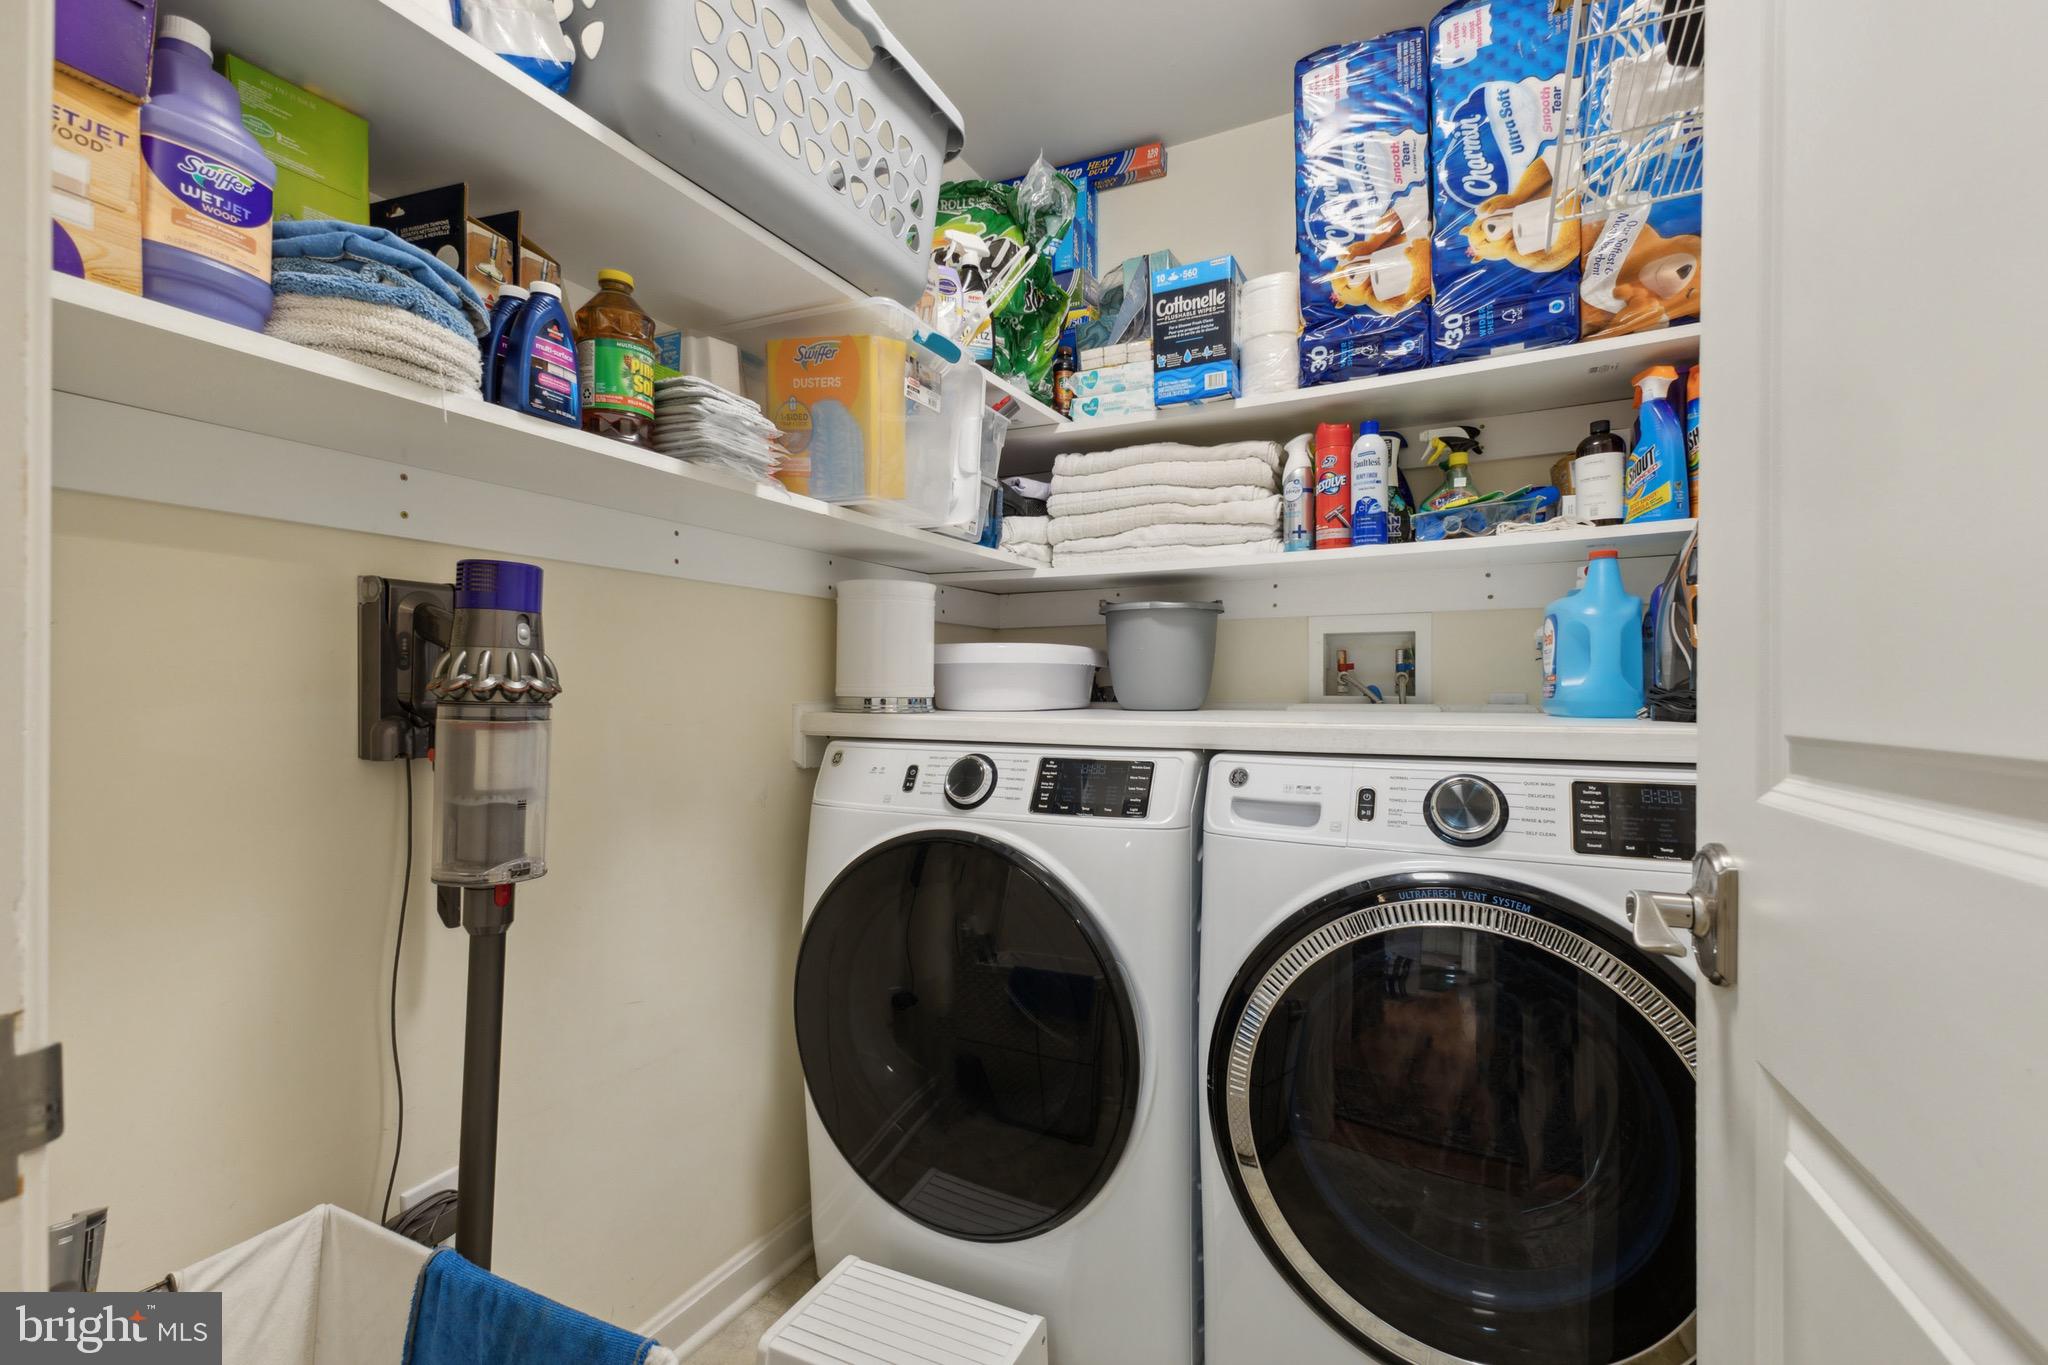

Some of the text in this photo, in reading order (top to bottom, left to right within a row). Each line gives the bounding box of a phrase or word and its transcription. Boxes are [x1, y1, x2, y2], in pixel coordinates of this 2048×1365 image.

[1540, 86, 1552, 133] Smooth
[1552, 86, 1562, 113] Tear
[1496, 88, 1525, 155] Ultra Soft
[53, 124, 105, 153] OOD
[1087, 157, 1118, 170] HEAVY
[1402, 141, 1410, 167] Tear
[1453, 113, 1498, 197] Charmin
[177, 155, 253, 196] Swiffer
[1088, 166, 1110, 177] DUTY
[201, 203, 238, 224] WOOD
[940, 197, 976, 210] ROLLS
[1156, 273, 1166, 283] 10
[1156, 288, 1226, 317] Cottonelle
[1165, 306, 1217, 321] FLUSHABLE WIPES
[1444, 313, 1463, 347] 30
[793, 344, 840, 368] Swiffer
[793, 376, 842, 389] DUSTERS
[1353, 457, 1381, 469] Faultless
[1398, 889, 1532, 914] ULTRAFRESH VENT SYSTEM
